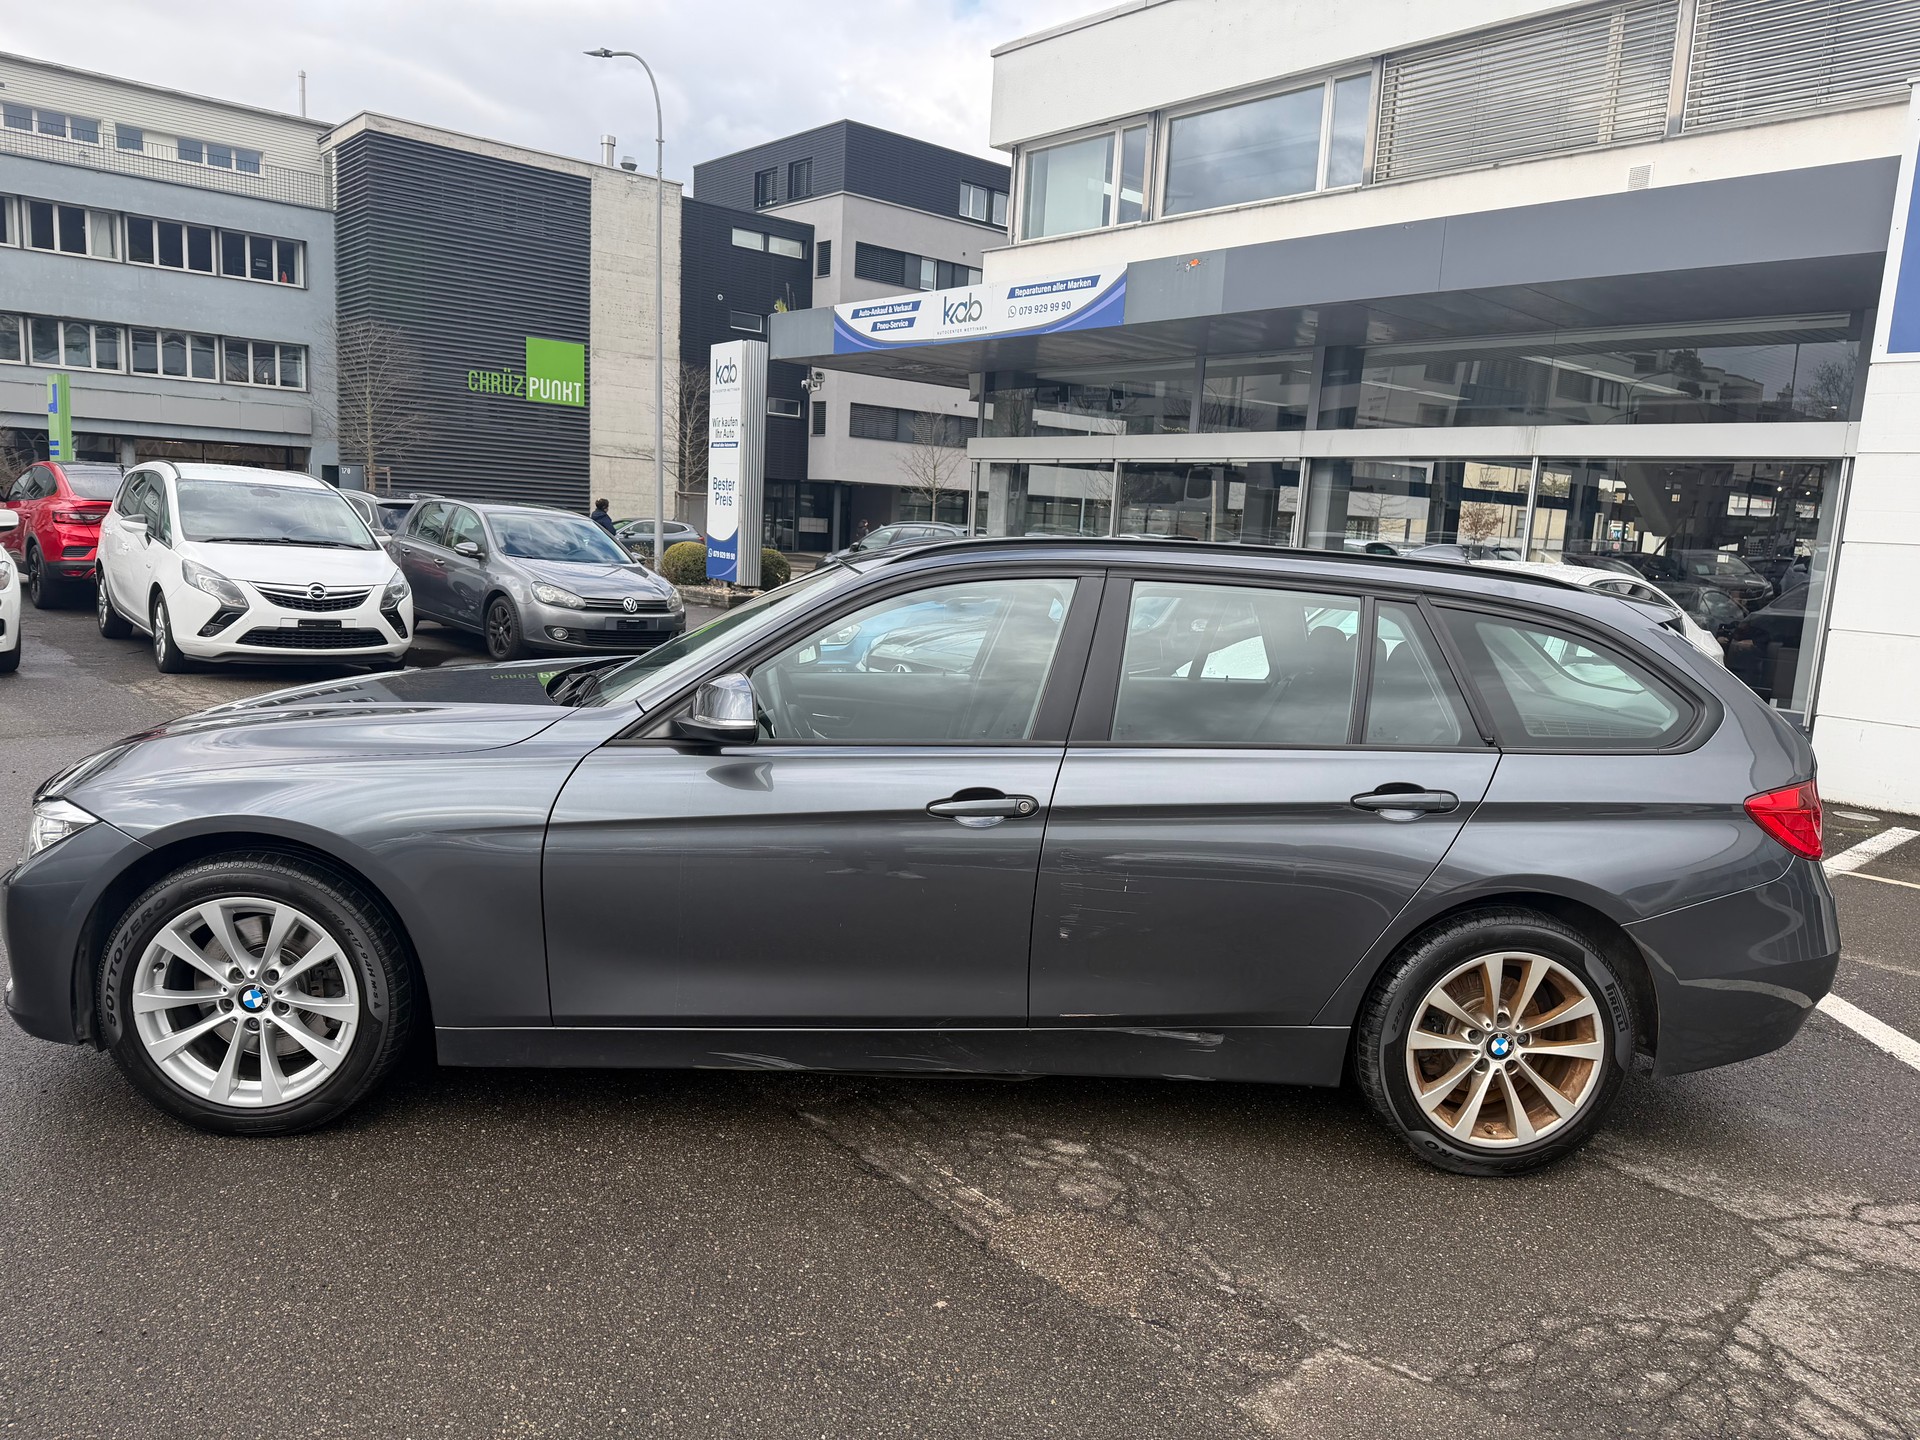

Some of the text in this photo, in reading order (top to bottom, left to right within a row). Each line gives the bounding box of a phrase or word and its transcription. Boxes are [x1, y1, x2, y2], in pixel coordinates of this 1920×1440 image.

[1014, 279, 1092, 297] Reparaturen aller Marken
[858, 302, 913, 317] Auto-Ankauf & Verkauf
[942, 292, 983, 326] kab
[1018, 300, 1072, 316] 079 929 99 90
[876, 319, 909, 330] Pneu-Service
[715, 357, 738, 385] kab
[468, 367, 524, 396] CHRÜZ
[529, 376, 582, 403] PUNKT
[712, 416, 738, 428] Wir kaufen
[723, 427, 735, 439] Auto
[713, 477, 735, 491] Bester
[715, 491, 733, 507] Preis
[105, 897, 167, 1027] SOTTOZERO
[1604, 982, 1630, 1033] PIRELLI
